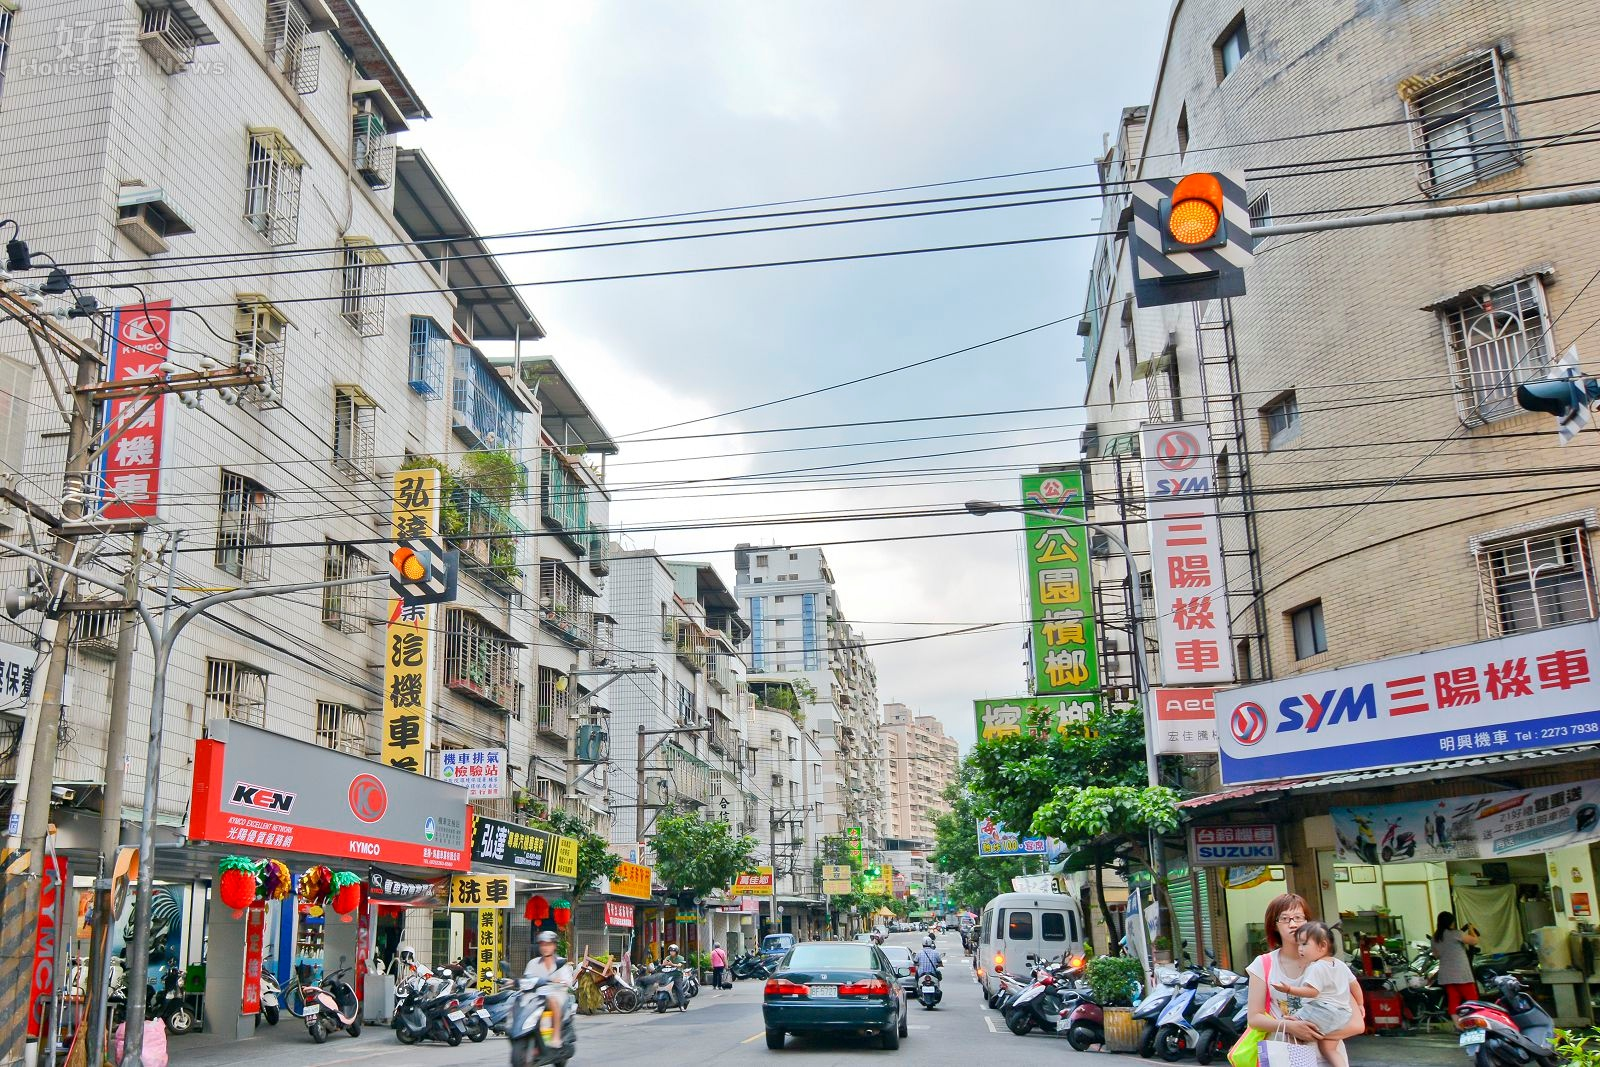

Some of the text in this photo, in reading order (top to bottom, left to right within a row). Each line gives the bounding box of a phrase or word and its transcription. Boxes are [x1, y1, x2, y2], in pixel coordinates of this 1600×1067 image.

[122, 342, 162, 354] KYMCO
[1155, 476, 1210, 496] SYM
[1164, 512, 1220, 672] 三陽機車
[1034, 528, 1090, 687] 公園檳榔
[1386, 648, 1591, 718] 三陽機車
[1275, 683, 1378, 733] SYM
[1541, 726, 1568, 738] 2273
[1571, 722, 1599, 734] 7938
[1439, 730, 1510, 752] 明興機車
[443, 751, 499, 765] 機車排氣
[454, 765, 498, 777] 檢驗站
[232, 784, 294, 812] KEN
[480, 824, 508, 861] 弘達
[1198, 828, 1273, 842] 台鈴機車
[349, 840, 380, 855] KYMCO
[1199, 846, 1274, 858] SUZUKI
[451, 879, 508, 904] 洗車
